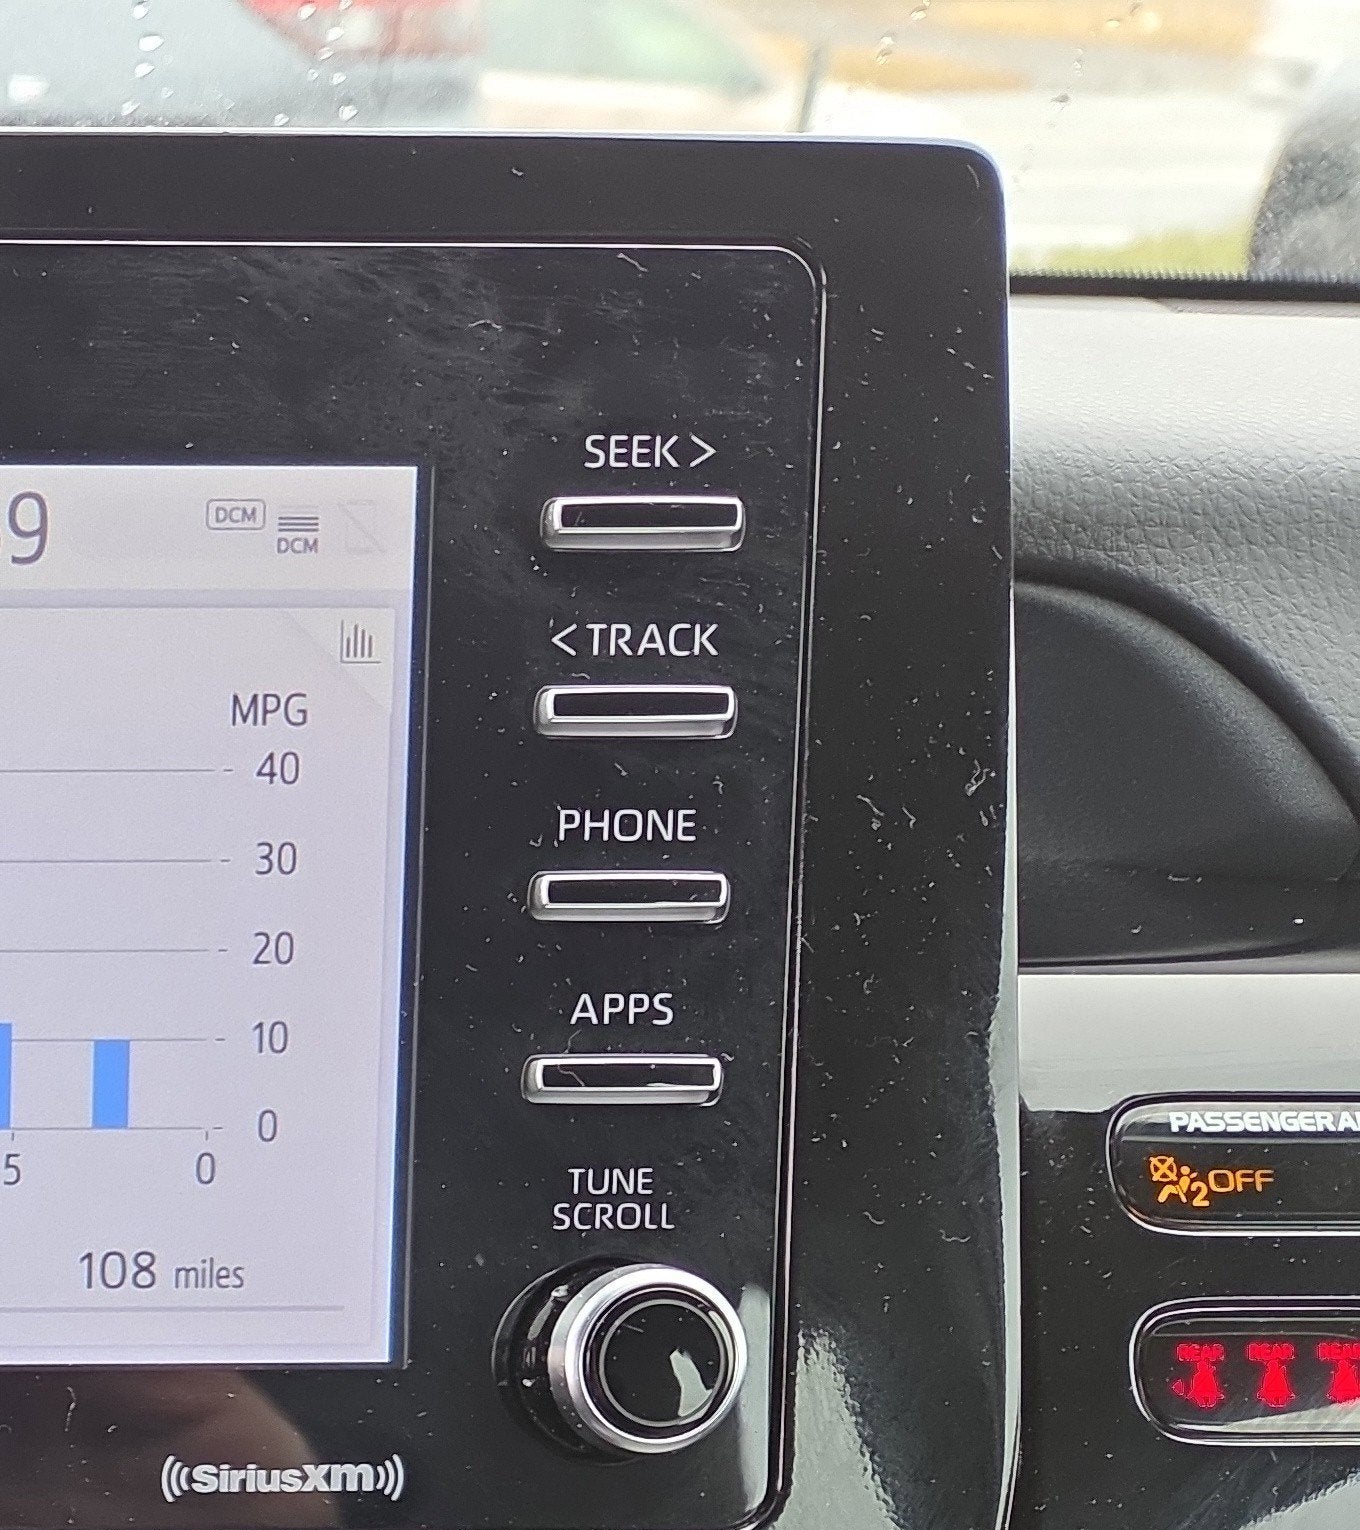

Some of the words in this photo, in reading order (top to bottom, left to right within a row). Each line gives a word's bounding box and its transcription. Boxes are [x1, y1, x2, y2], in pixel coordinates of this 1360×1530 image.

[215, 506, 257, 523] DCM
[277, 537, 319, 554] DCM
[231, 694, 308, 726] MPG
[256, 752, 301, 785] 40
[558, 809, 697, 842] PHONE
[254, 842, 298, 875] 30
[251, 932, 295, 965] 20
[569, 993, 674, 1025] APPS
[251, 1022, 289, 1054] 10
[257, 1110, 278, 1142] 0
[1169, 1111, 1336, 1133] PASSENGER
[3, 1153, 22, 1185] 5
[195, 1153, 216, 1184] 0
[567, 1167, 654, 1195] TUNE
[1207, 1169, 1275, 1193] OFF
[552, 1203, 675, 1230] SCROLL
[79, 1251, 157, 1290] 108
[174, 1259, 245, 1290] miles
